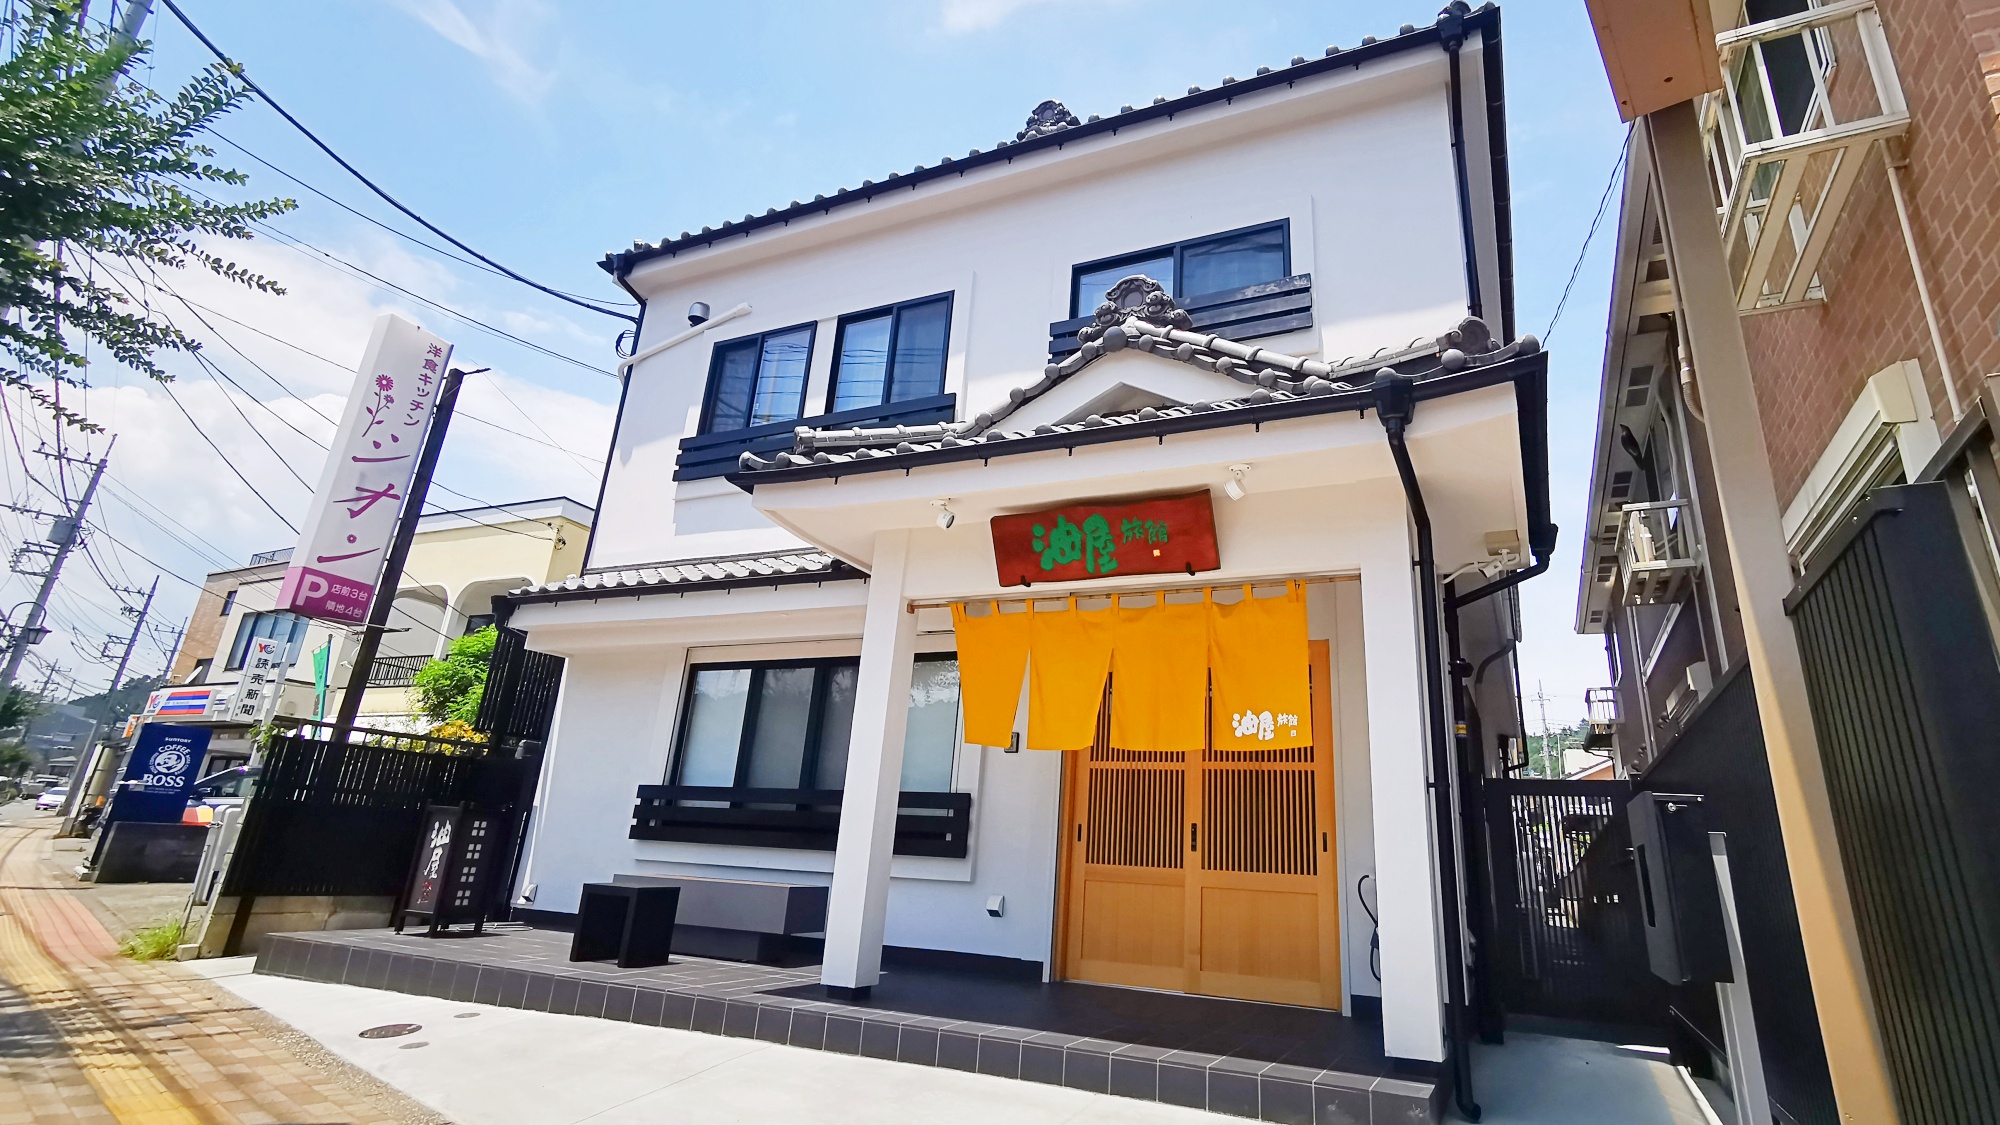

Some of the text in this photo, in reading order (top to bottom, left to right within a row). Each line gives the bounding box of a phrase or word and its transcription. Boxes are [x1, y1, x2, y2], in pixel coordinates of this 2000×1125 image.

[404, 342, 443, 426] 洋食キッチン
[1032, 513, 1168, 574] 油屋 旅館
[295, 573, 329, 606] P
[331, 584, 368, 601] 店前3台
[240, 658, 270, 716] 読売新聞
[158, 744, 191, 756] COFFEE
[142, 773, 185, 788] BOSS
[423, 819, 452, 879] 油屋
